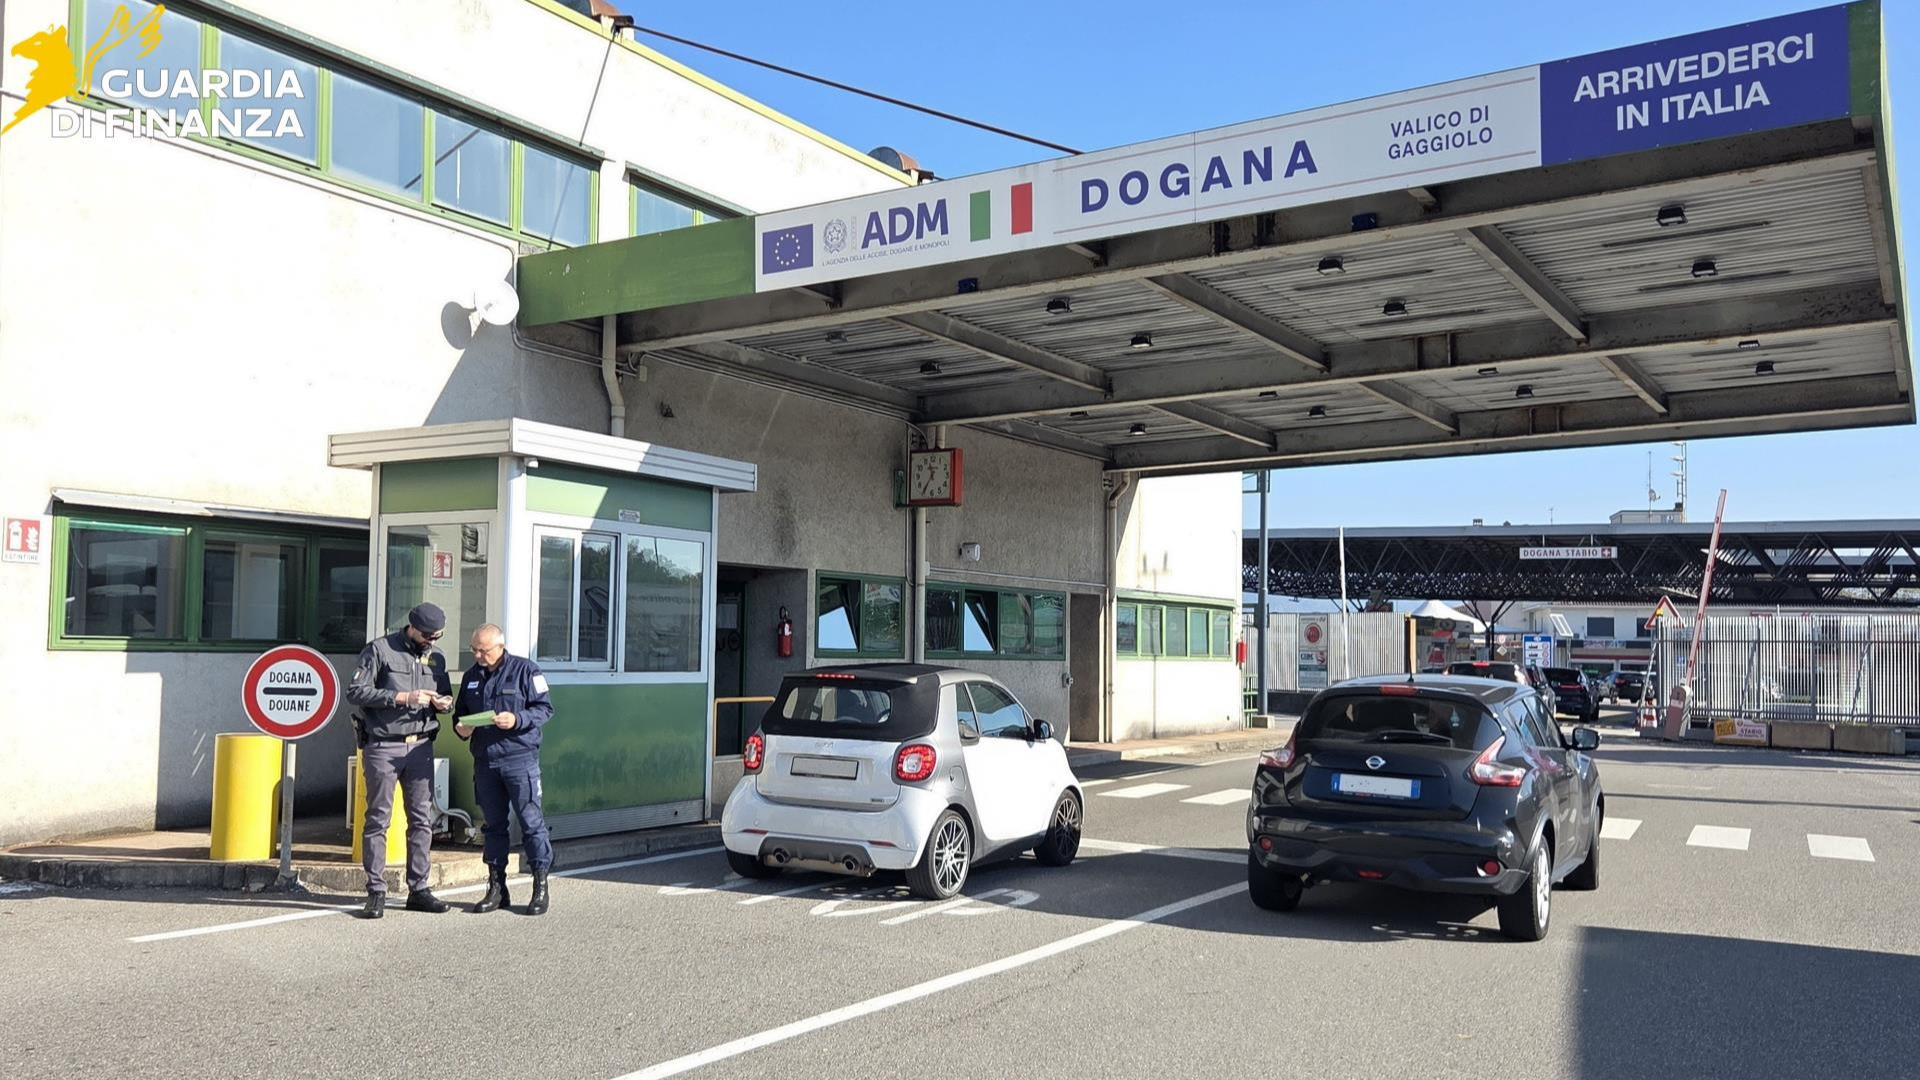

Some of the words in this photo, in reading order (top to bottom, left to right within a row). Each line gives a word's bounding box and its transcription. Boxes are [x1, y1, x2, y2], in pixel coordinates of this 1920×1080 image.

[1573, 33, 1814, 102] ARRIVEDERCI
[1391, 112, 1462, 138] VALICO
[1469, 105, 1490, 124] DI
[1616, 101, 1649, 131] IN
[1661, 81, 1770, 123] ITALIA
[1388, 127, 1493, 160] GAGGIOLO
[1081, 140, 1318, 213] DOGANA
[861, 198, 949, 249] ADM
[889, 245, 913, 256] DOGANE
[1523, 549, 1561, 557] DOGANA
[1566, 548, 1598, 557] STABIO
[269, 671, 312, 684] DOGANA
[269, 699, 311, 712] DOUANE
